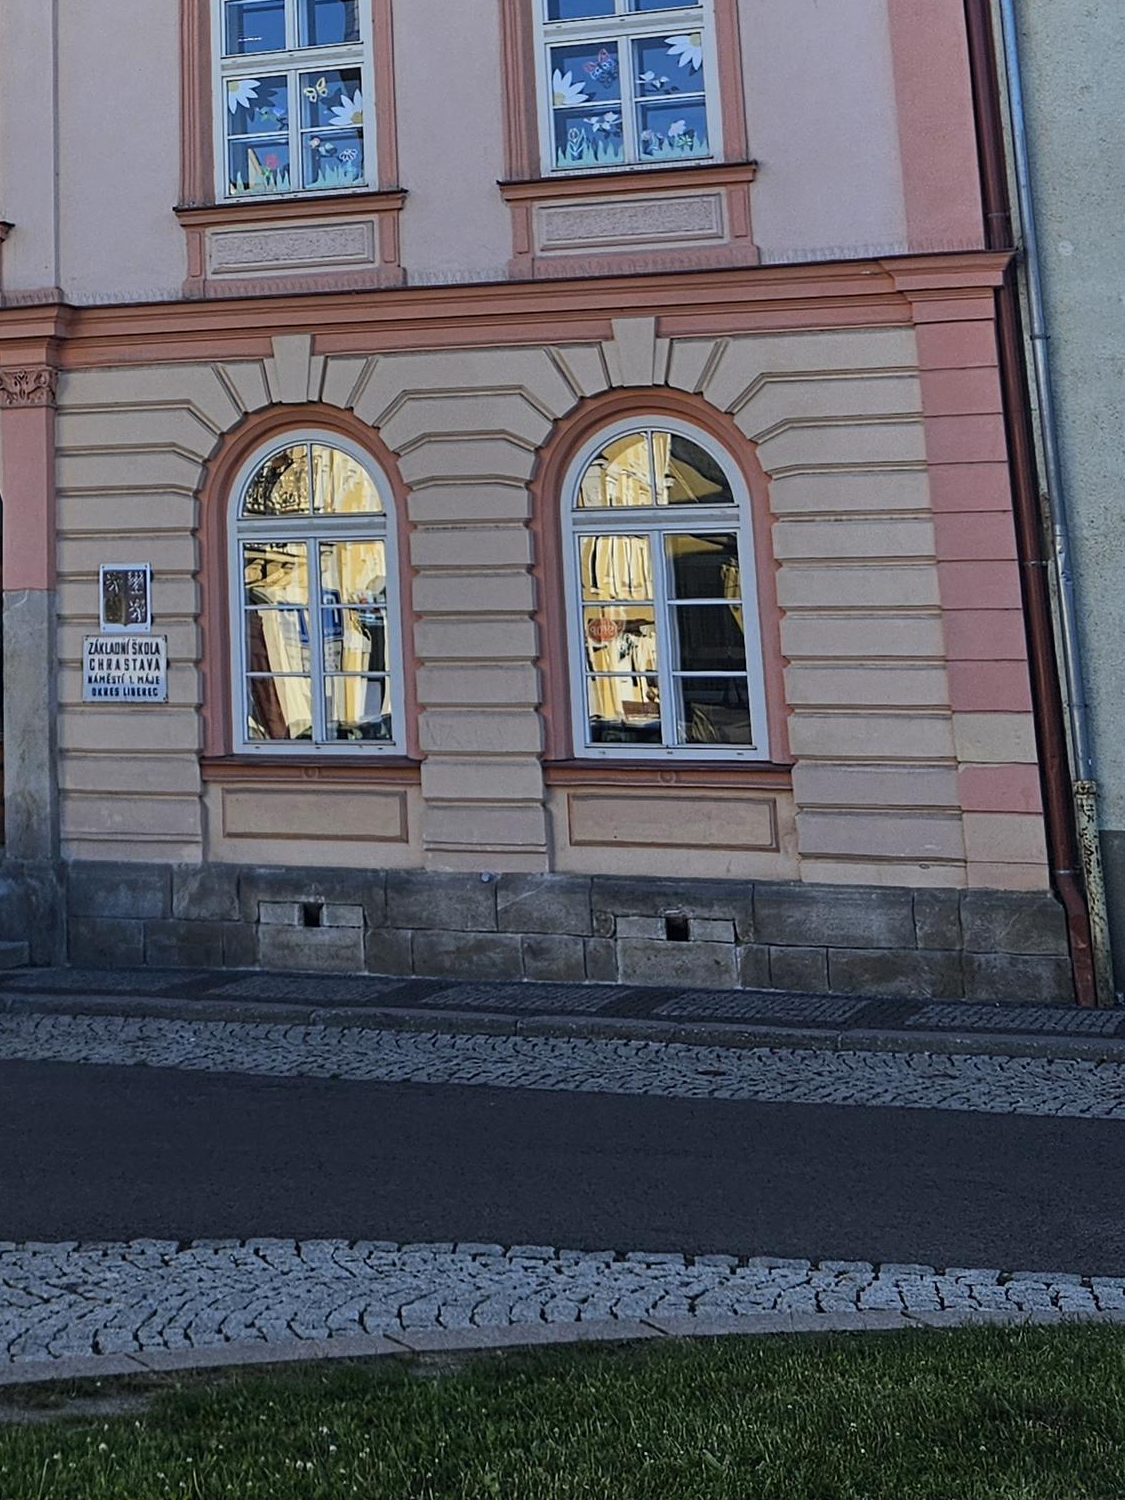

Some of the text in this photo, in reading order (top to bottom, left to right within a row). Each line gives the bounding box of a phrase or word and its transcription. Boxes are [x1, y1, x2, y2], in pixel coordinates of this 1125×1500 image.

[88, 638, 160, 655] ZÁKLADNÍ ŠKOLA
[89, 658, 160, 671] CHRASTAVA
[87, 673, 160, 685] NÁMĚSTÍ 1. MÁJE
[91, 687, 158, 697] OKRES LIBEREC
